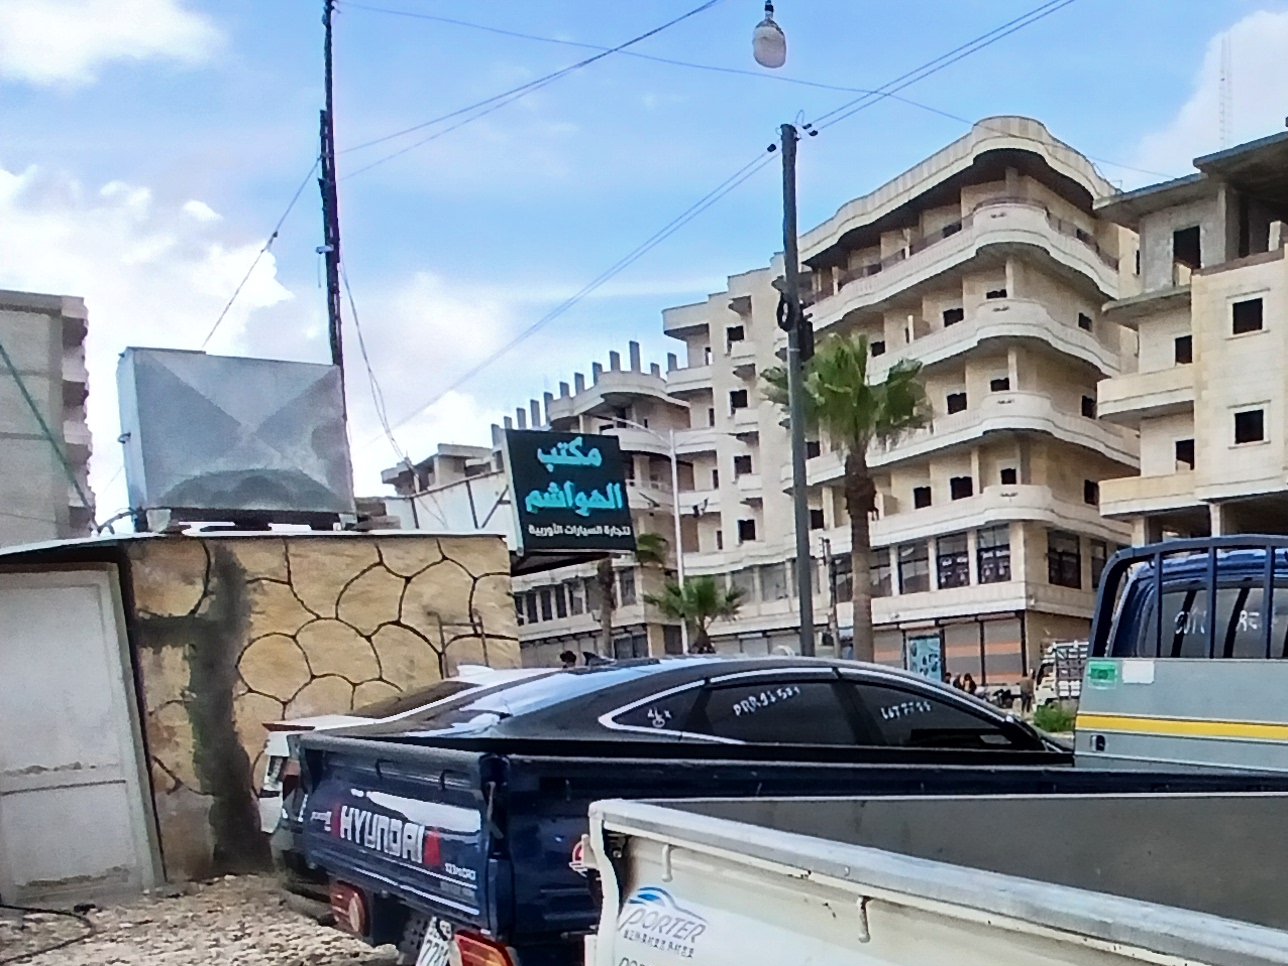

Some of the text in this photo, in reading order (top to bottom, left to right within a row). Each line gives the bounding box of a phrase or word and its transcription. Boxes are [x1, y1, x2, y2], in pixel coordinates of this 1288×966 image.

[537, 436, 603, 473] مكتب
[339, 805, 427, 865] HYUNDAI
[617, 907, 707, 944] PORTER
